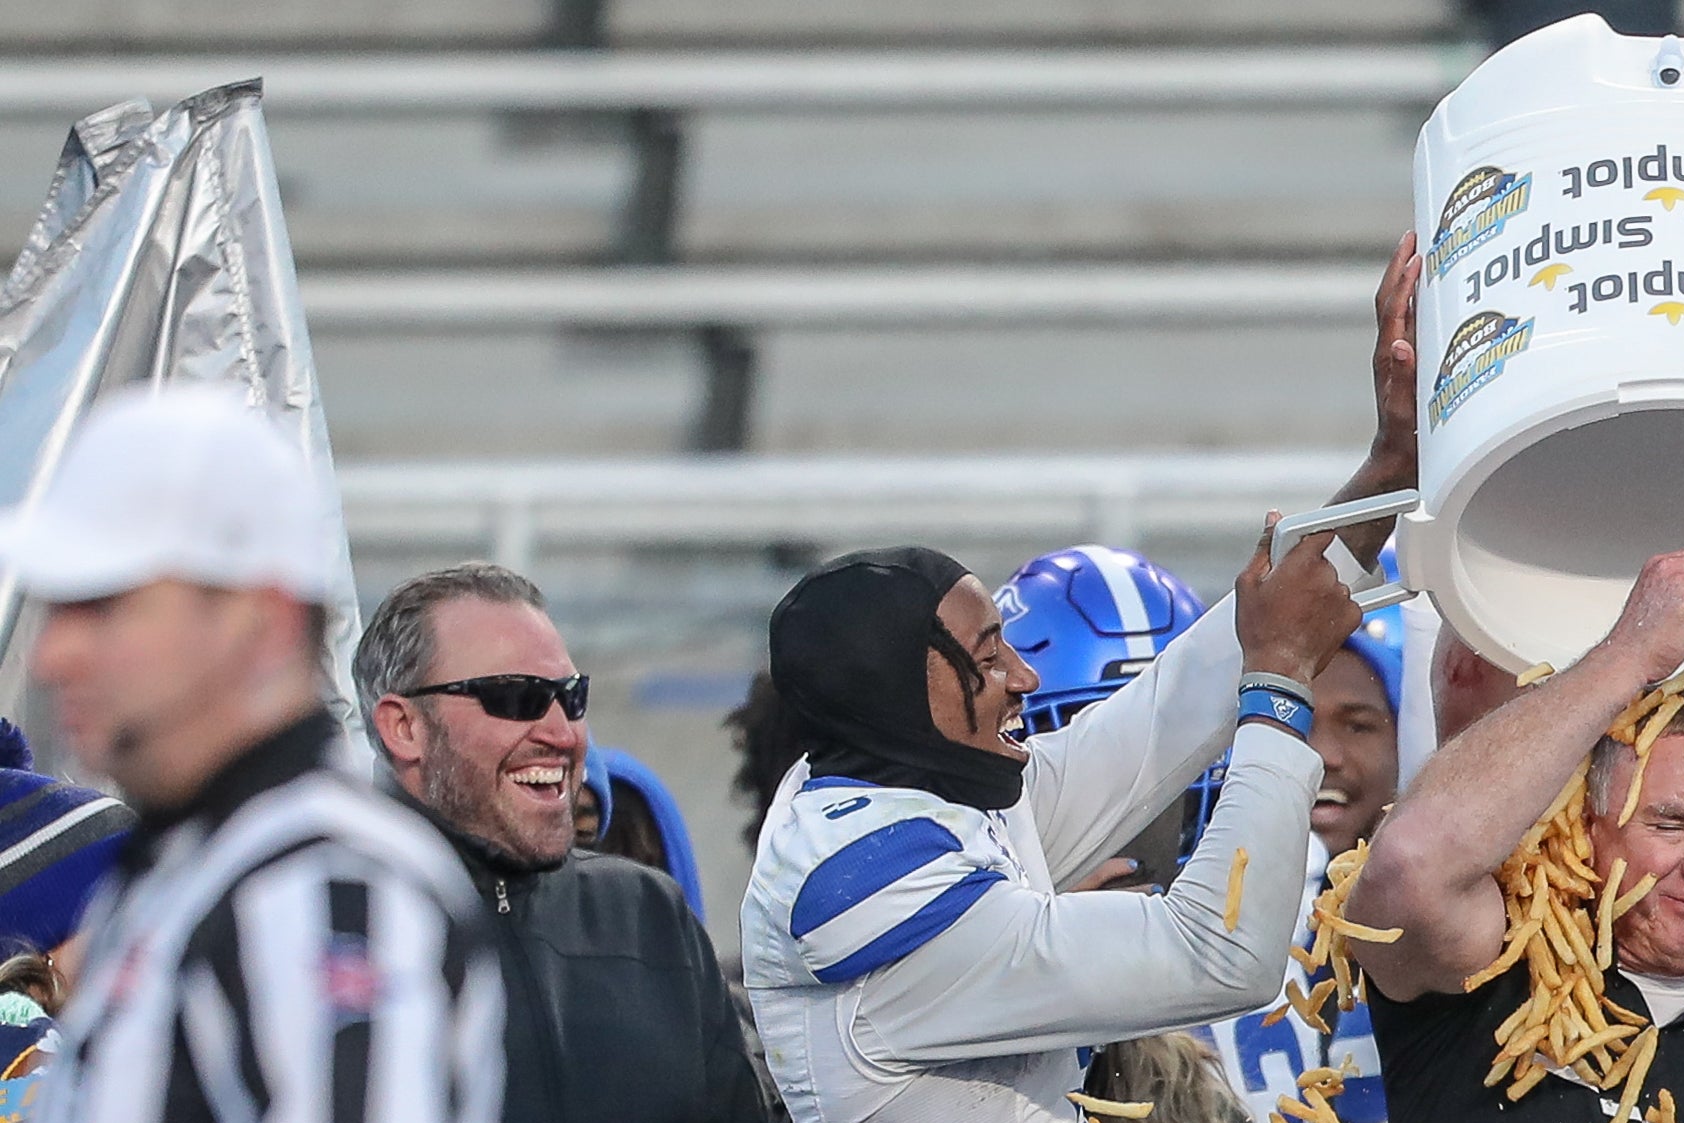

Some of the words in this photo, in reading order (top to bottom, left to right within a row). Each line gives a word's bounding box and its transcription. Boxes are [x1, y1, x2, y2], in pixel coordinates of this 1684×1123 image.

[1444, 175, 1496, 219] BOWL
[1444, 226, 1497, 271] FAMOUS
[1465, 215, 1655, 304] Simplot
[1446, 319, 1497, 366] BOWL
[1446, 367, 1496, 416] FAMOUS
